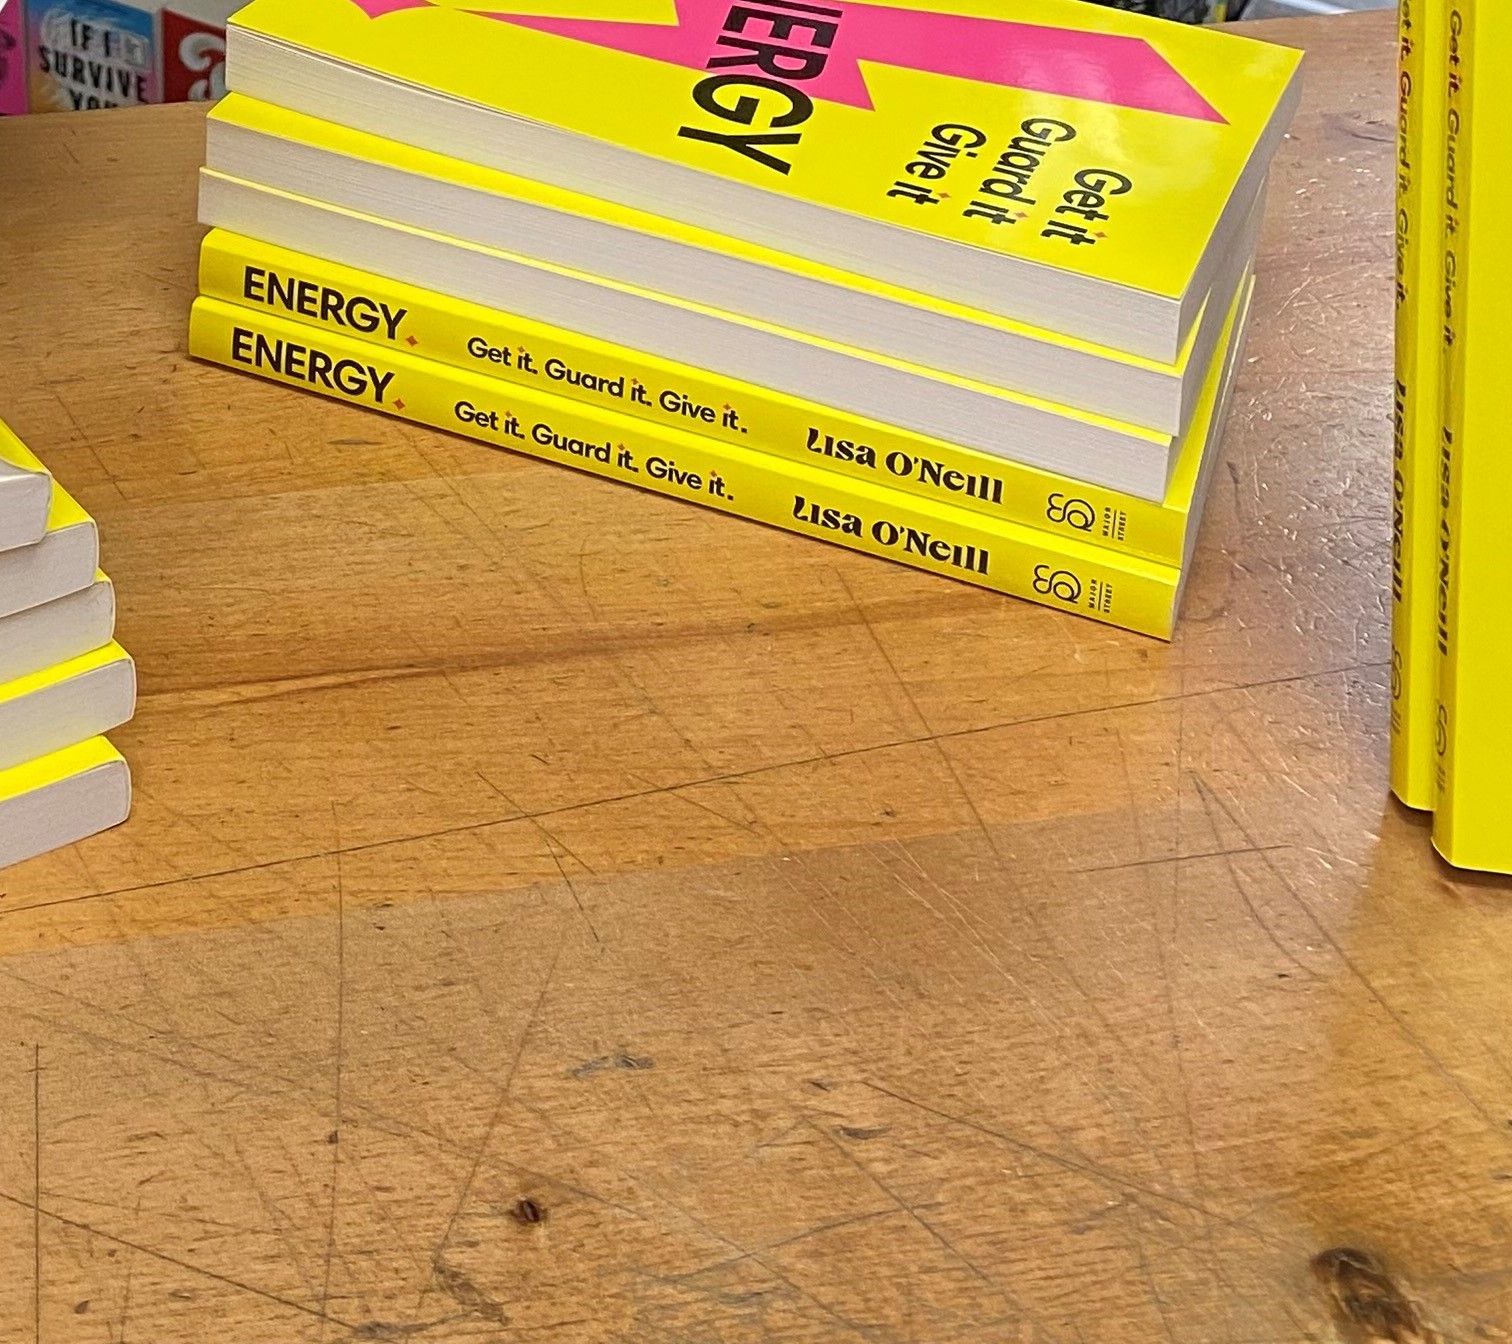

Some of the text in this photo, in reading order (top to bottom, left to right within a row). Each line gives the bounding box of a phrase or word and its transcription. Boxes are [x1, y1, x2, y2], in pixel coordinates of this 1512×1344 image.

[70, 18, 92, 51] IF
[1448, 8, 1463, 68] Get
[38, 44, 148, 104] SURVIVE
[1398, 70, 1412, 170] Guard
[886, 122, 988, 208] Give it
[975, 117, 1078, 205] Guard
[1445, 107, 1461, 212] Guard
[962, 201, 1032, 227] it
[1039, 168, 1133, 247] Get it
[1395, 207, 1409, 279] Give
[1443, 249, 1458, 320] Give
[466, 336, 749, 435] Get it. Guard it. Give it.
[1393, 379, 1407, 462] Lisa
[454, 400, 735, 502] Get it. Guard it. Give it.
[805, 426, 1005, 505] Lisa O'Neill
[791, 495, 990, 576] Lisa O'Neill
[1101, 506, 1113, 538] MAJOR
[1116, 510, 1128, 542] STREET
[1087, 577, 1099, 610] MAJOR
[1103, 582, 1114, 615] STREET
